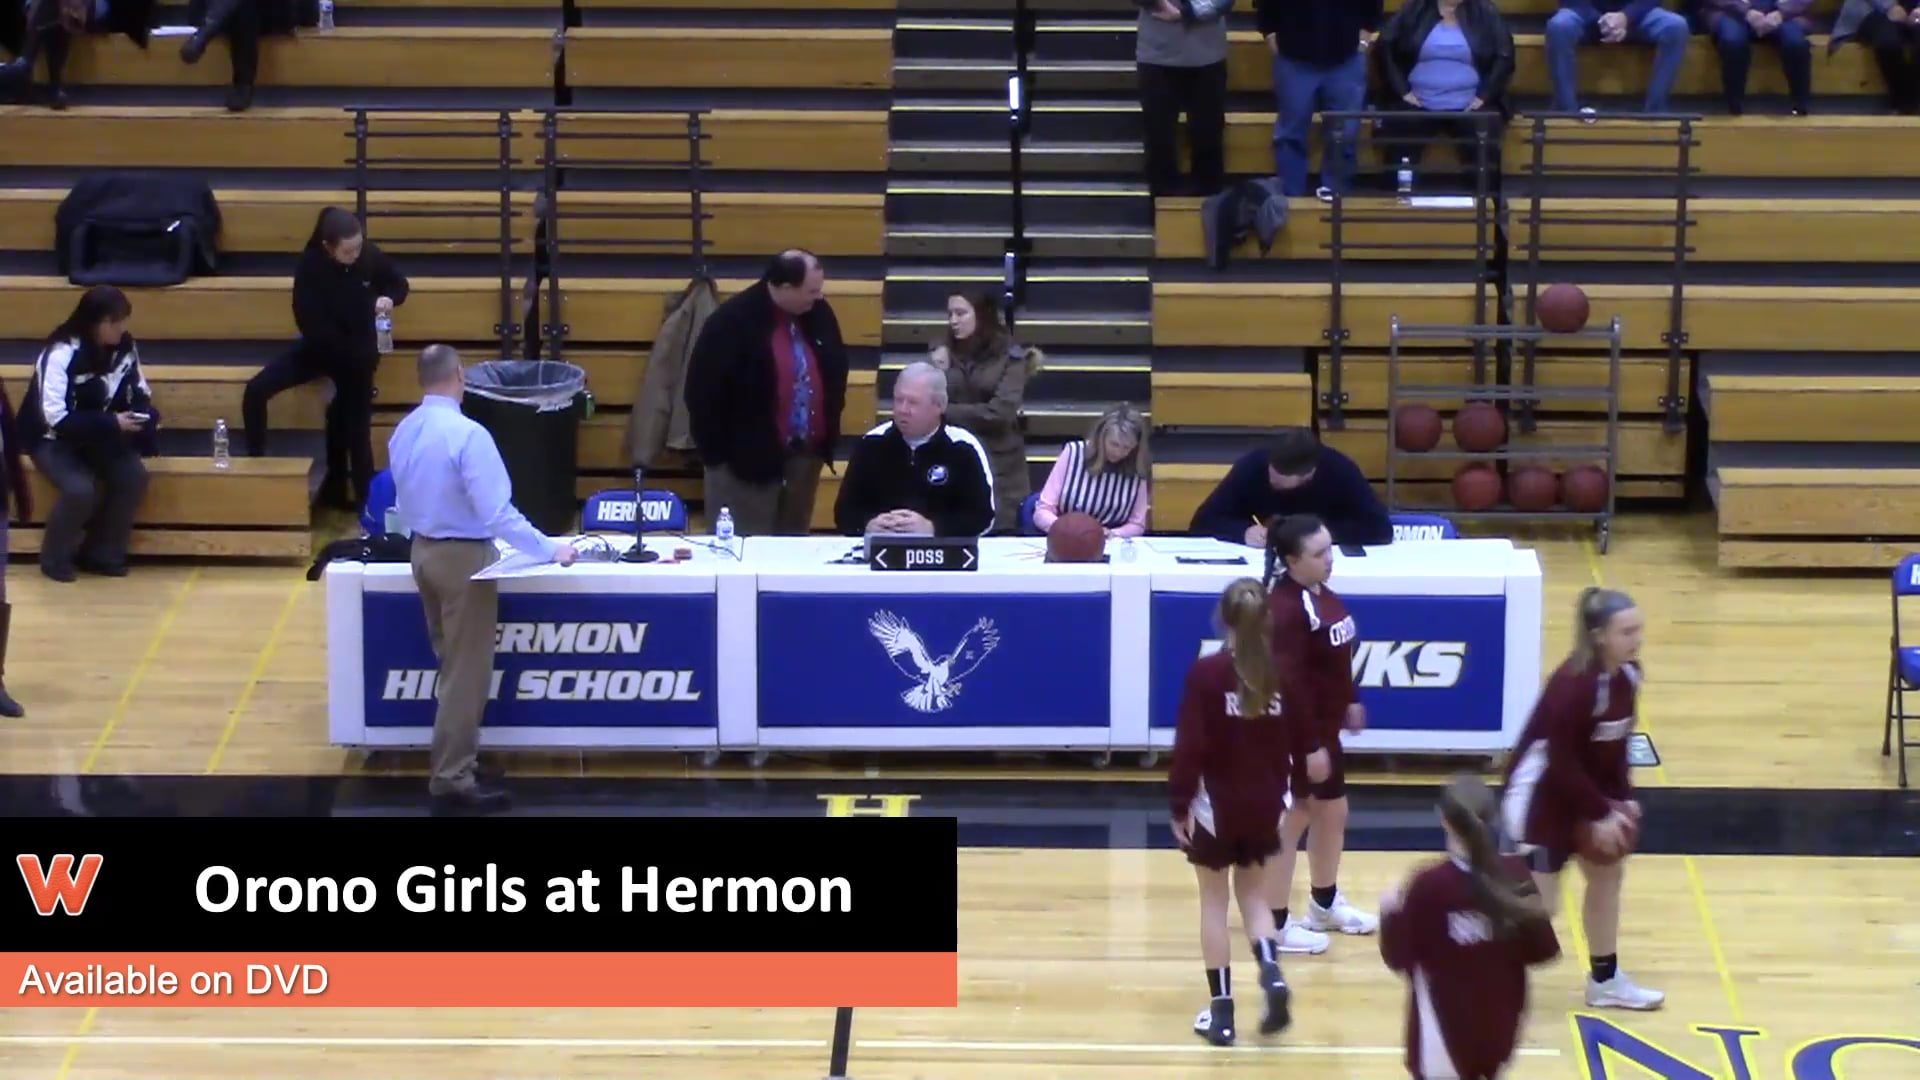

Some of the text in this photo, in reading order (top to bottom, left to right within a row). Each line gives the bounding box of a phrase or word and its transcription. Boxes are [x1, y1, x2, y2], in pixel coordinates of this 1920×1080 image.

[906, 549, 944, 568] poss
[496, 623, 649, 653] RMON
[516, 670, 701, 700] SCHOOL
